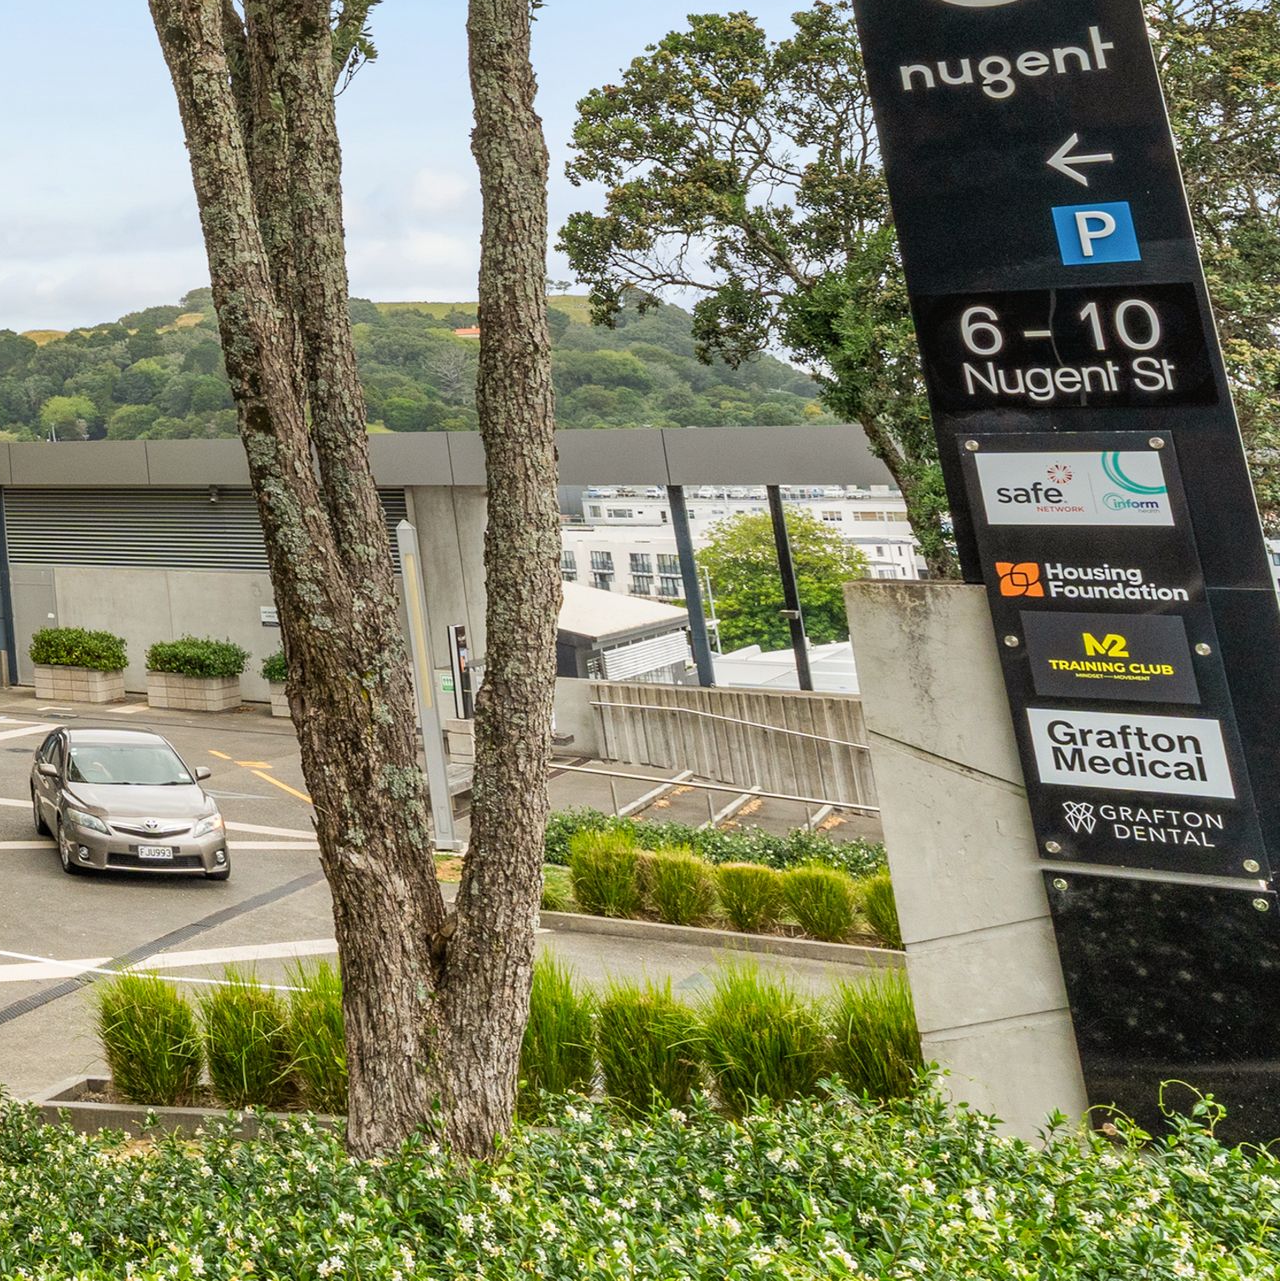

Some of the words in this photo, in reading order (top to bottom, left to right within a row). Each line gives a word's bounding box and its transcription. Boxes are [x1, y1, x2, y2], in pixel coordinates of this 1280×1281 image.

[900, 26, 1114, 99] nugent
[1075, 211, 1116, 257] P
[961, 306, 1003, 354] 6
[1079, 299, 1162, 351] 10
[963, 361, 1121, 401] Nugent
[1131, 356, 1175, 393] St
[996, 482, 1064, 504] safe
[1113, 498, 1159, 509] inform
[1037, 505, 1085, 513] NETWORK
[1045, 563, 1143, 584] Housing
[1049, 581, 1190, 602] Foundation
[1083, 633, 1130, 658] M2
[1048, 659, 1126, 674] TRAINING
[1129, 663, 1175, 676] CLUB
[1047, 720, 1203, 754] Grafton
[1051, 746, 1208, 782] Medical
[1099, 804, 1224, 830] GRAFTON
[1114, 824, 1216, 847] DENTAL
[140, 847, 171, 857] FJU993
